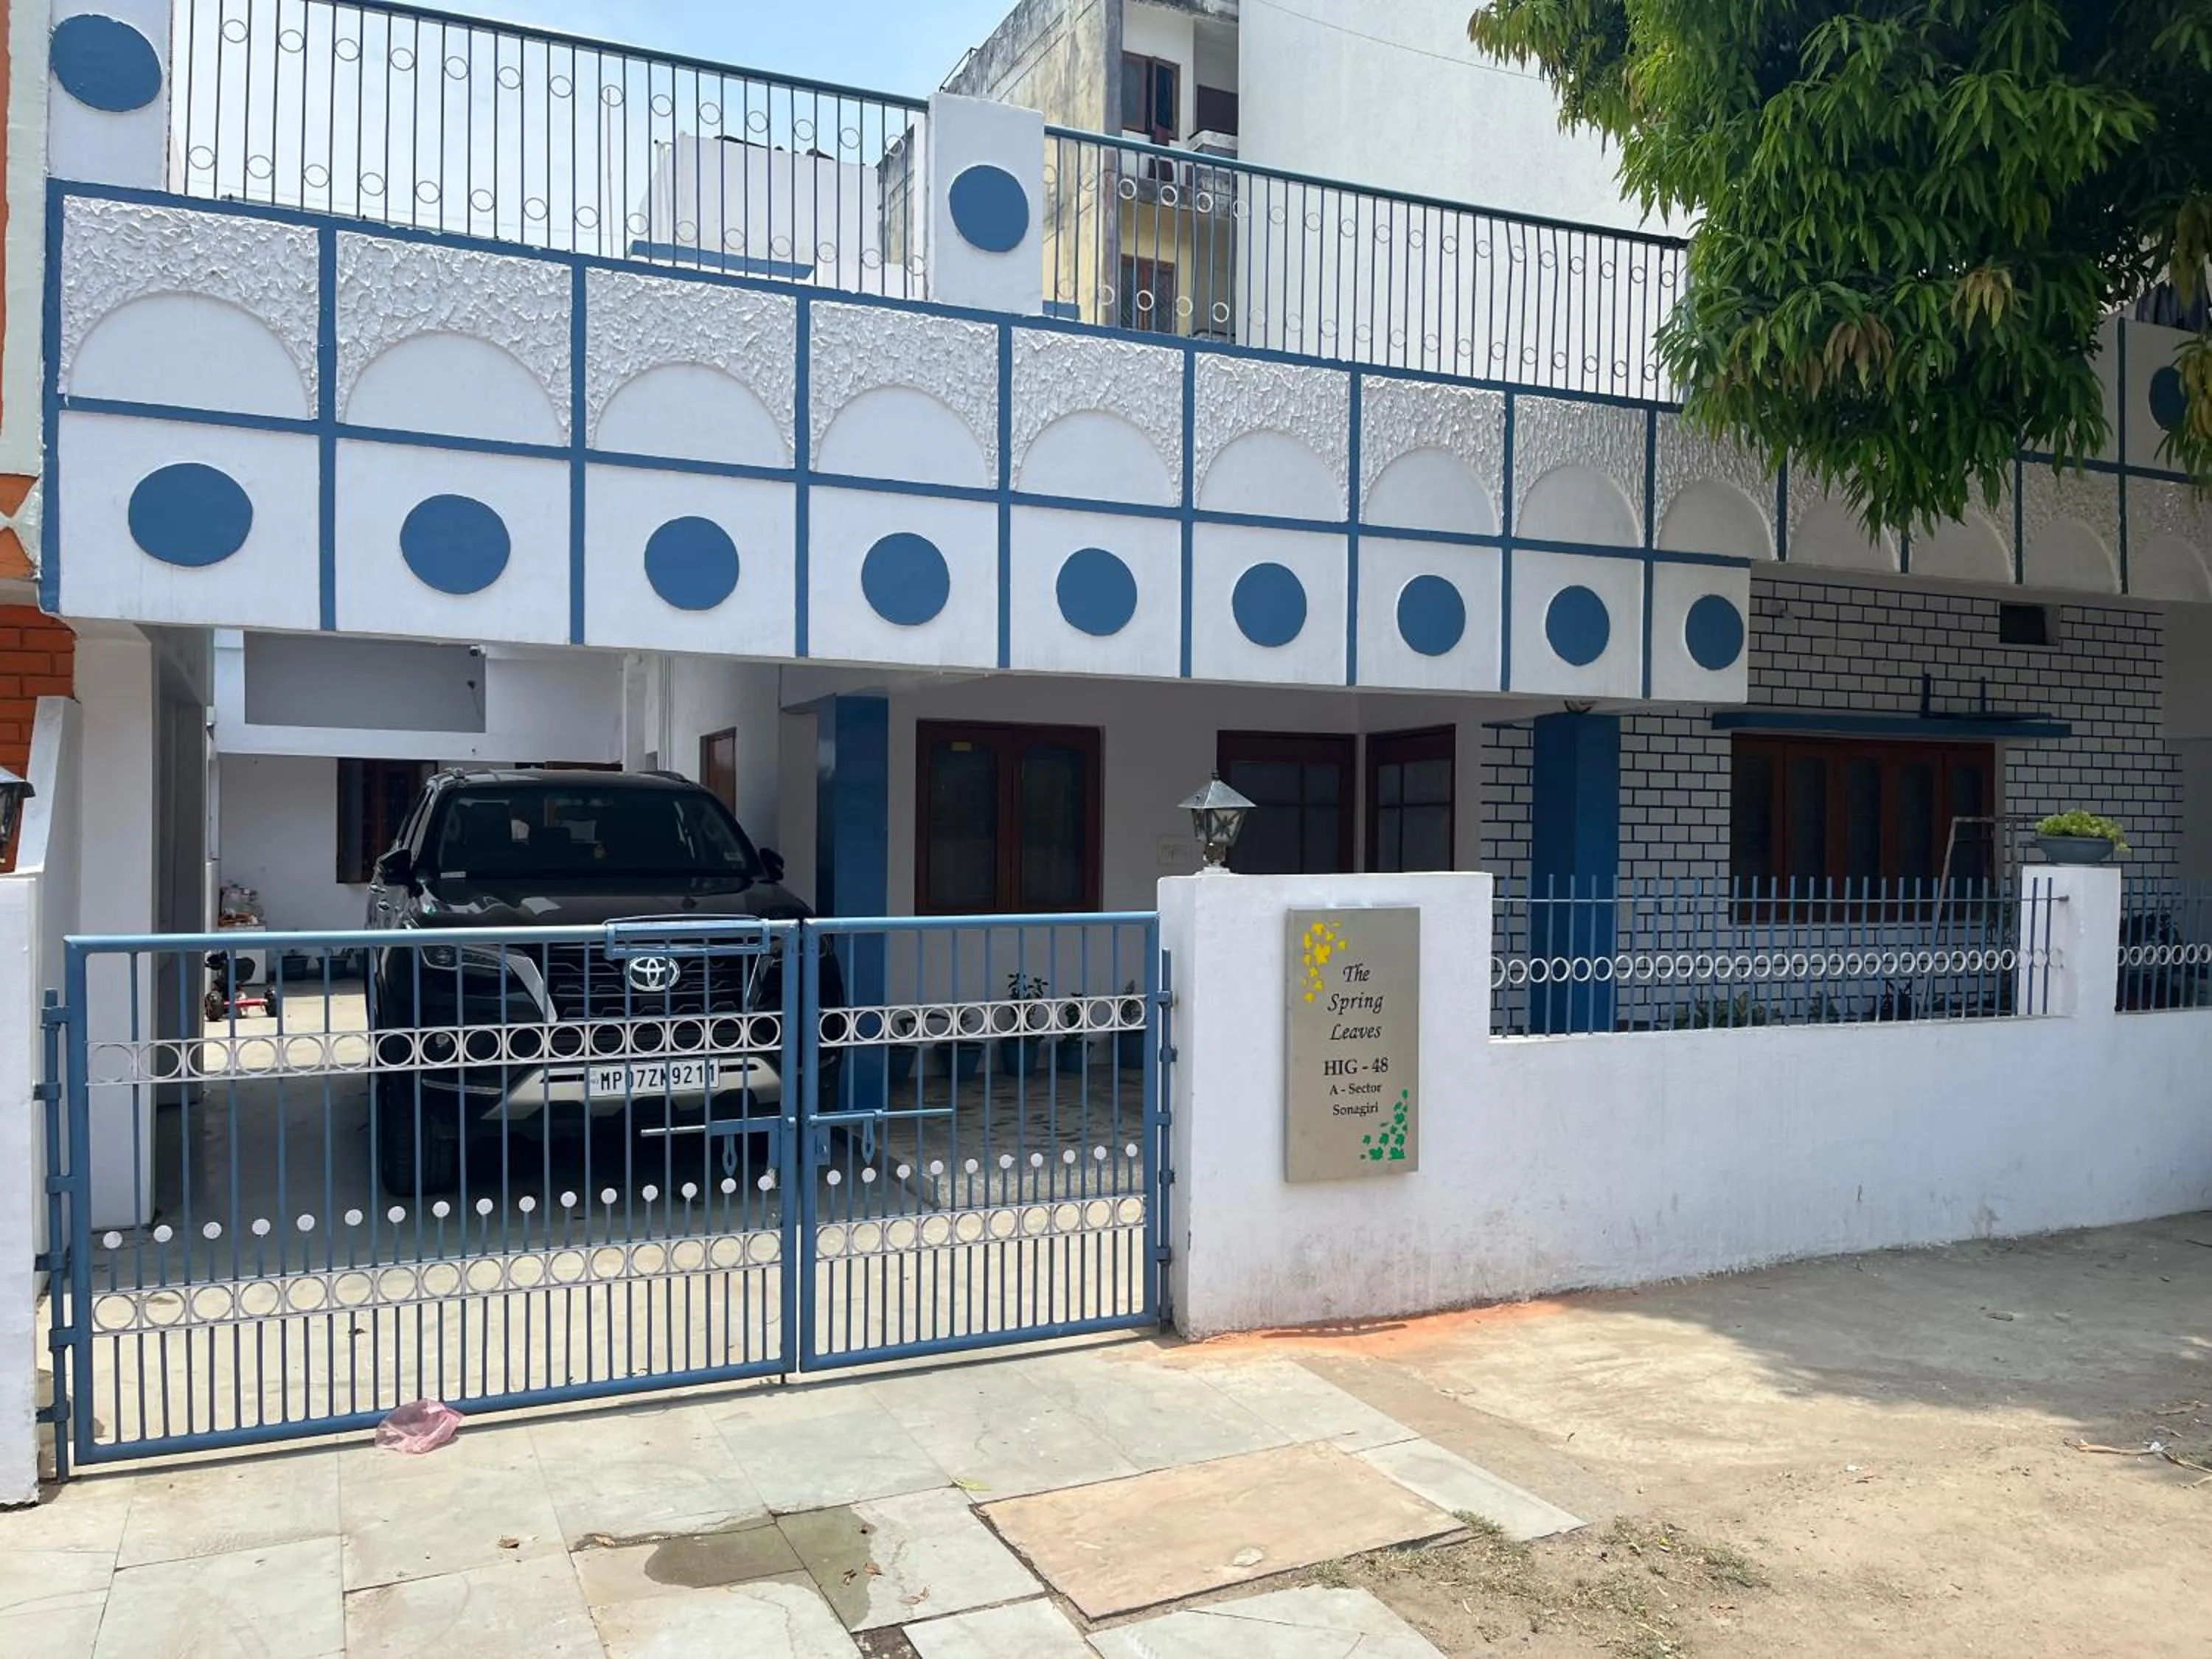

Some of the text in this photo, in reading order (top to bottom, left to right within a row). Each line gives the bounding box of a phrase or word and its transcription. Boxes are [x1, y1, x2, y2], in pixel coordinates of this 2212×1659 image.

[1343, 962, 1370, 982] The
[1327, 992, 1383, 1015] Spring
[1329, 1023, 1382, 1040] Leaves
[1324, 1059, 1357, 1076] HIG
[1371, 1057, 1389, 1073] 48
[1329, 1084, 1338, 1096] A
[1348, 1082, 1382, 1094] Sector
[1332, 1101, 1378, 1116] Sonagiri
